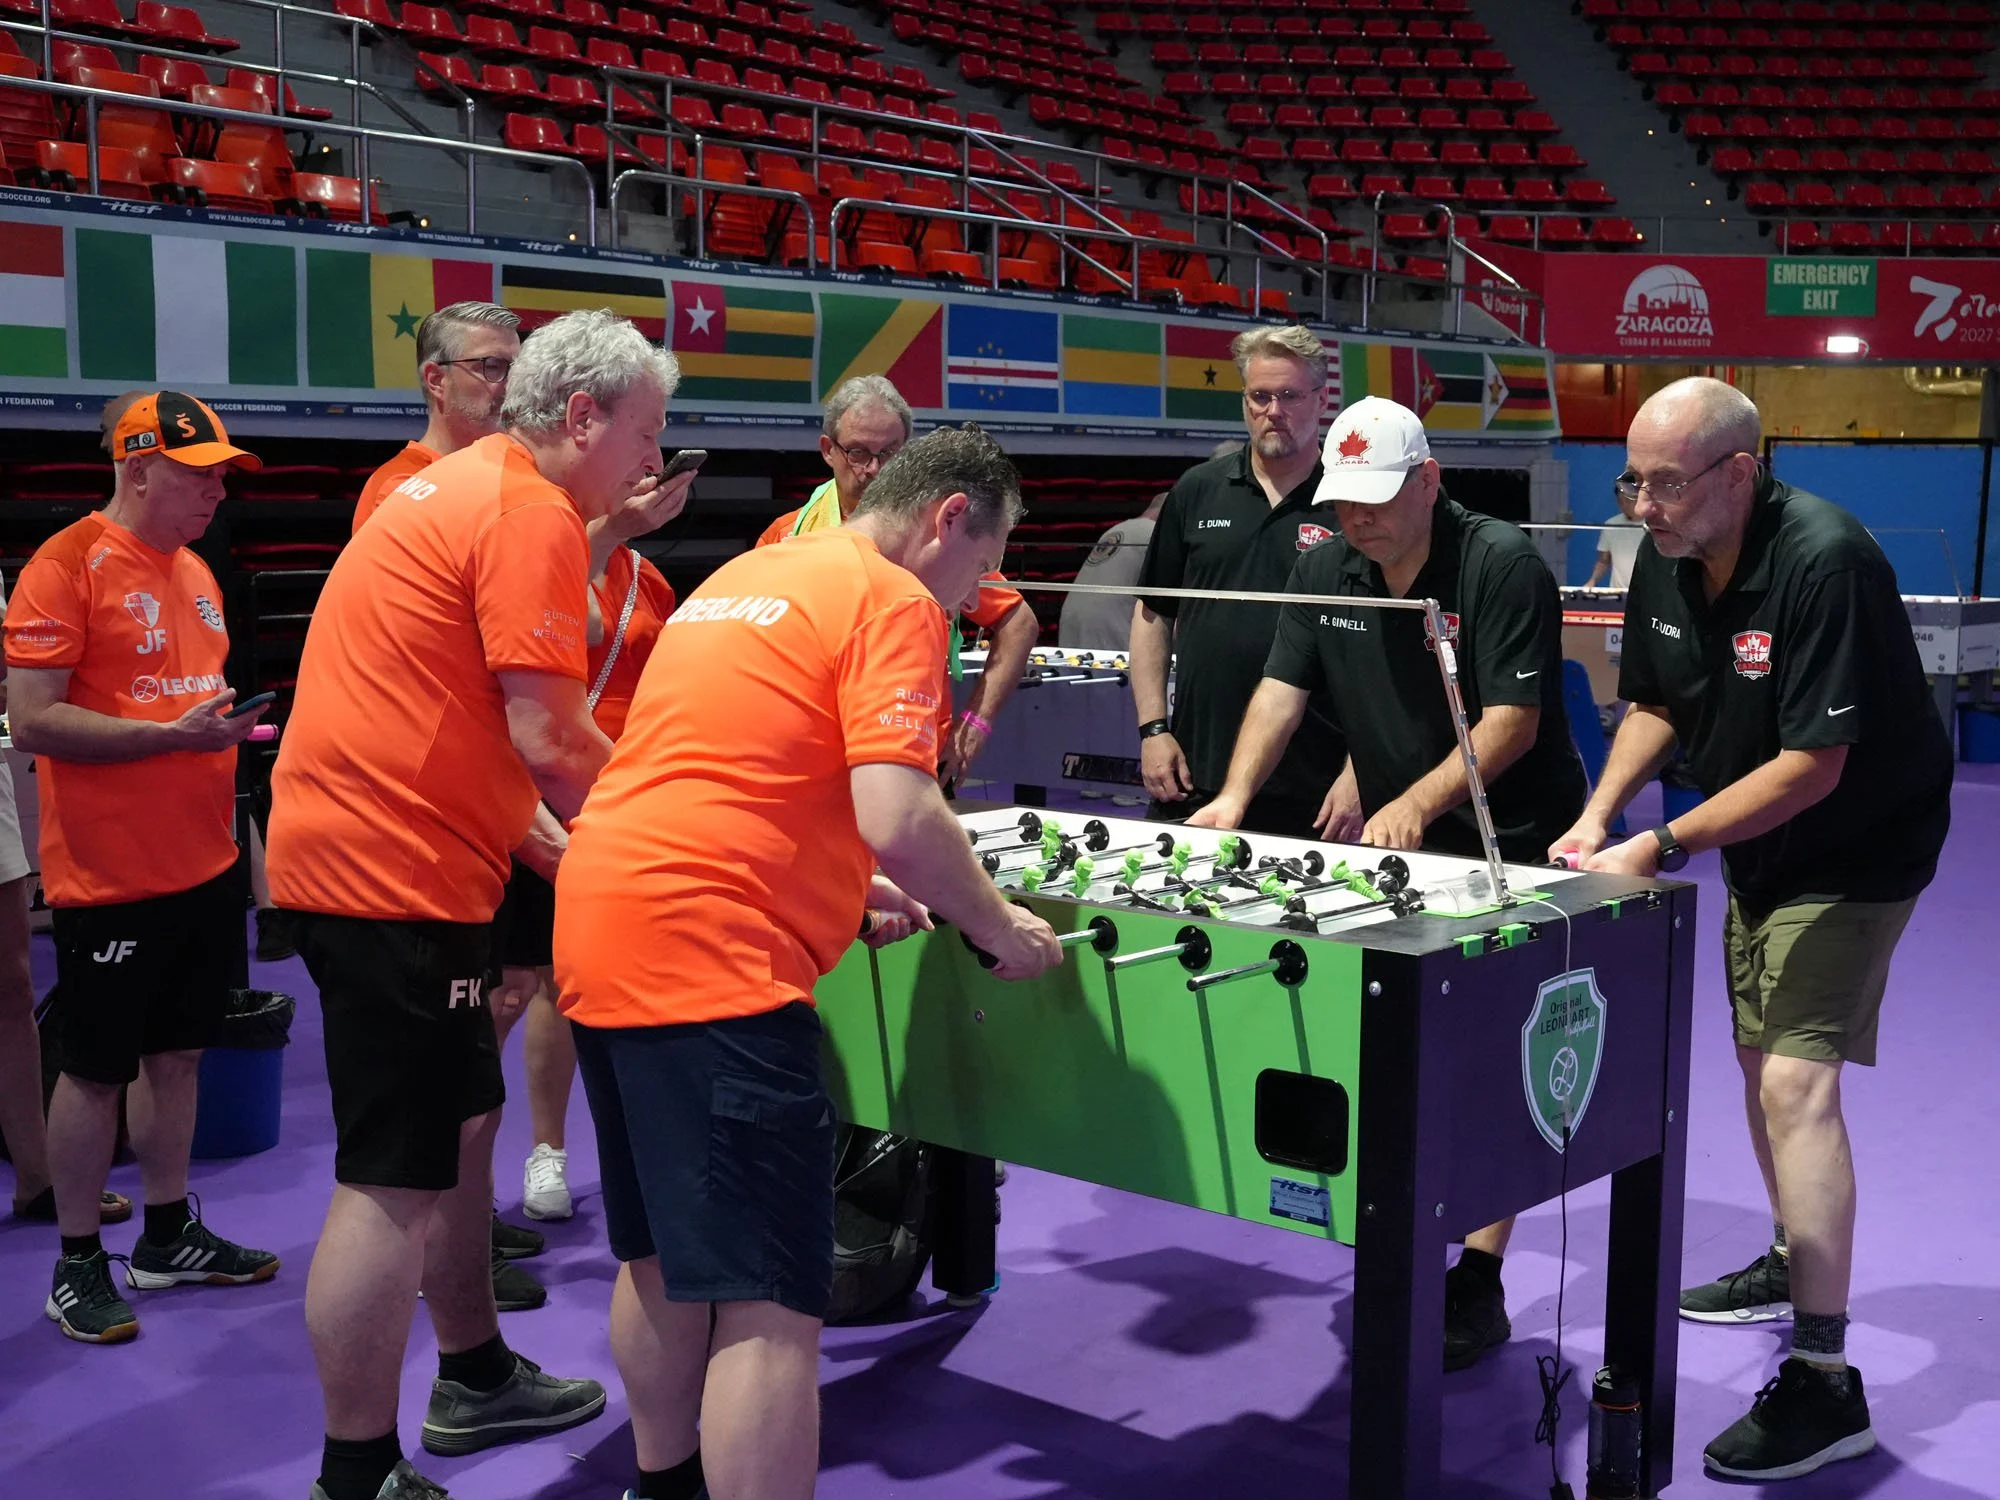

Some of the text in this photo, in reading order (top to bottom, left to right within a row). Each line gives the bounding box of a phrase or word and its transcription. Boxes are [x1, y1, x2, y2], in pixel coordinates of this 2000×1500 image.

[1773, 263, 1870, 286] EMERGENCY
[1803, 288, 1839, 310] EXIT
[1615, 314, 1714, 336] ZARAGOZA
[5, 397, 54, 406] FEDERATION
[1198, 519, 1231, 529] E. DUNN
[1319, 614, 1368, 631] R. GINELL
[136, 629, 167, 655] JF
[1913, 632, 1934, 642] 046
[93, 940, 138, 963] JF
[448, 978, 482, 1009] FK
